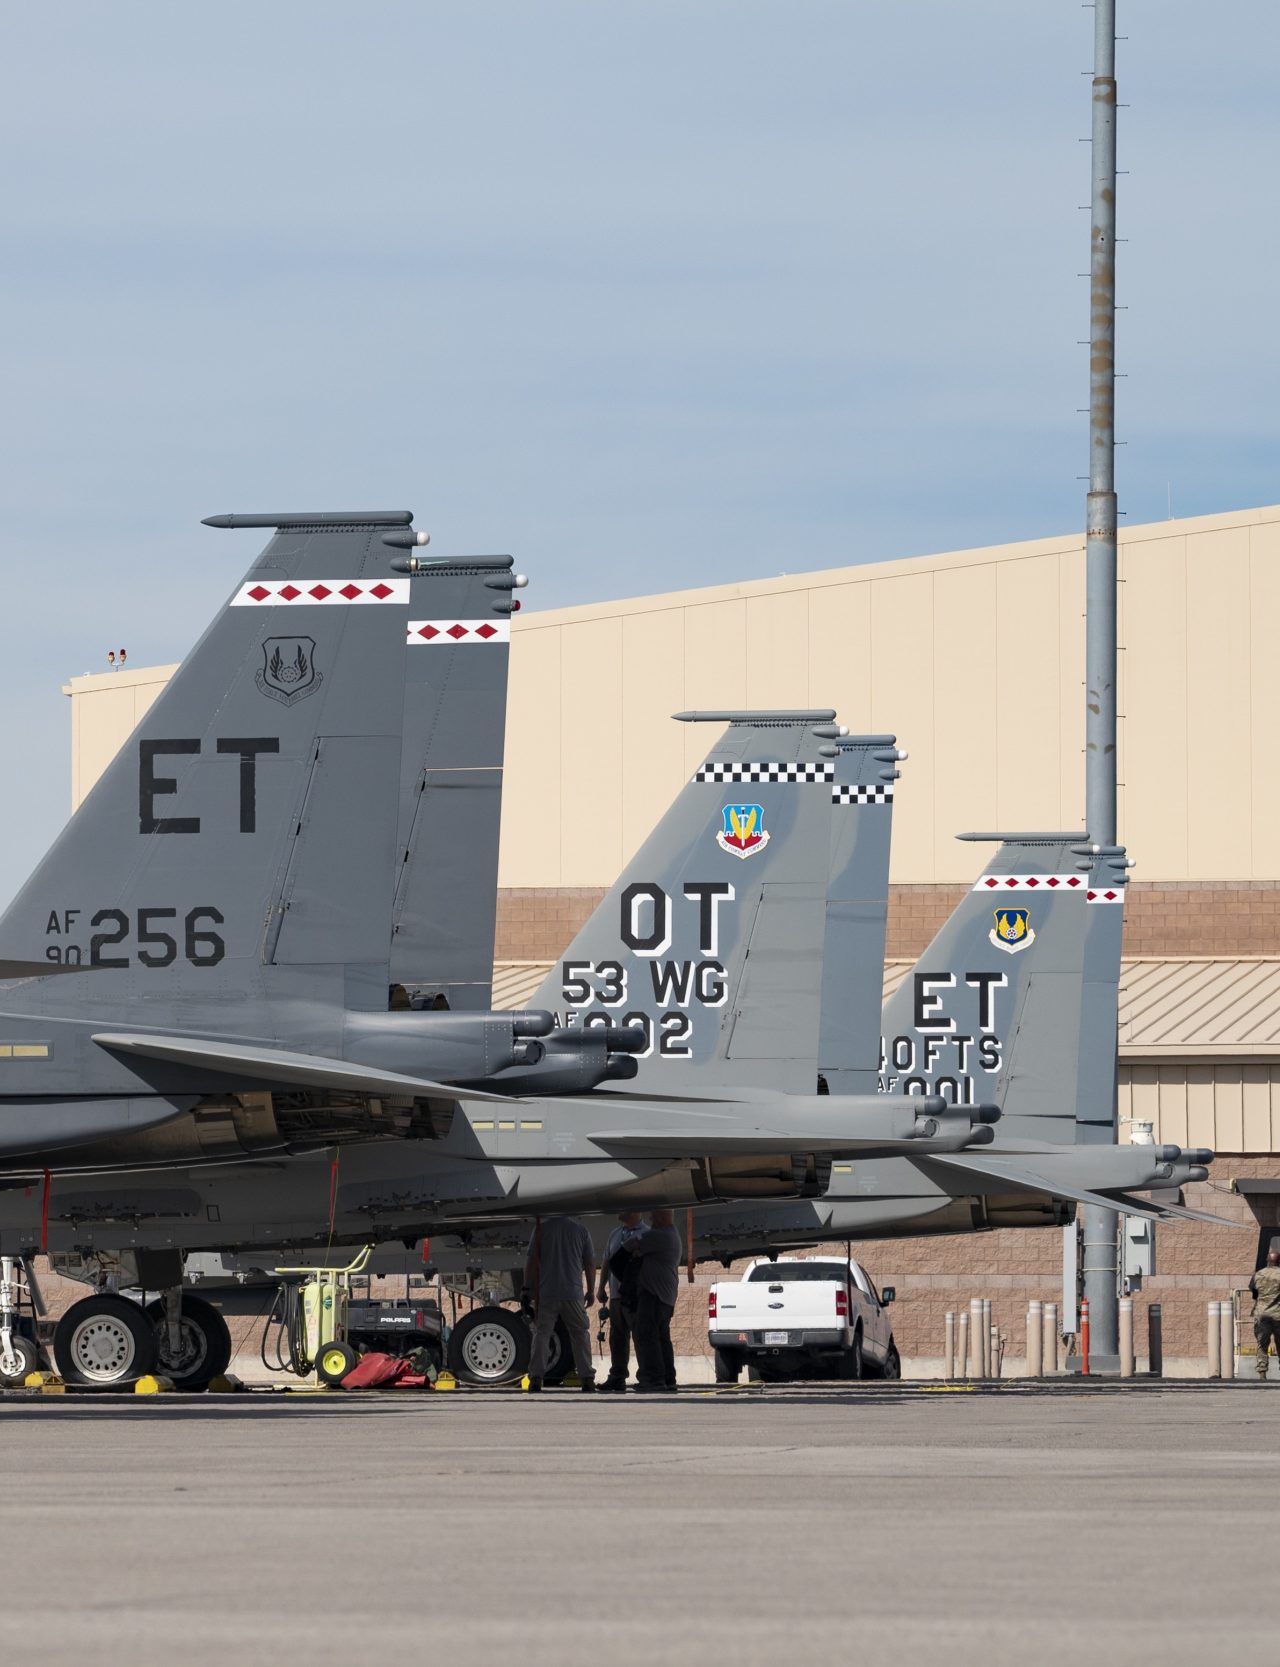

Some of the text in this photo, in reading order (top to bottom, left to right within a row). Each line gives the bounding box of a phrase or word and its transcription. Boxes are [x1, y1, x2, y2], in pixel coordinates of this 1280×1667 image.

[139, 737, 279, 835] ET
[45, 909, 81, 934] AF
[90, 906, 225, 969] 256
[621, 882, 736, 957] OT
[45, 946, 81, 965] 90
[562, 961, 729, 1008] 53 WG
[914, 972, 1008, 1033] ET
